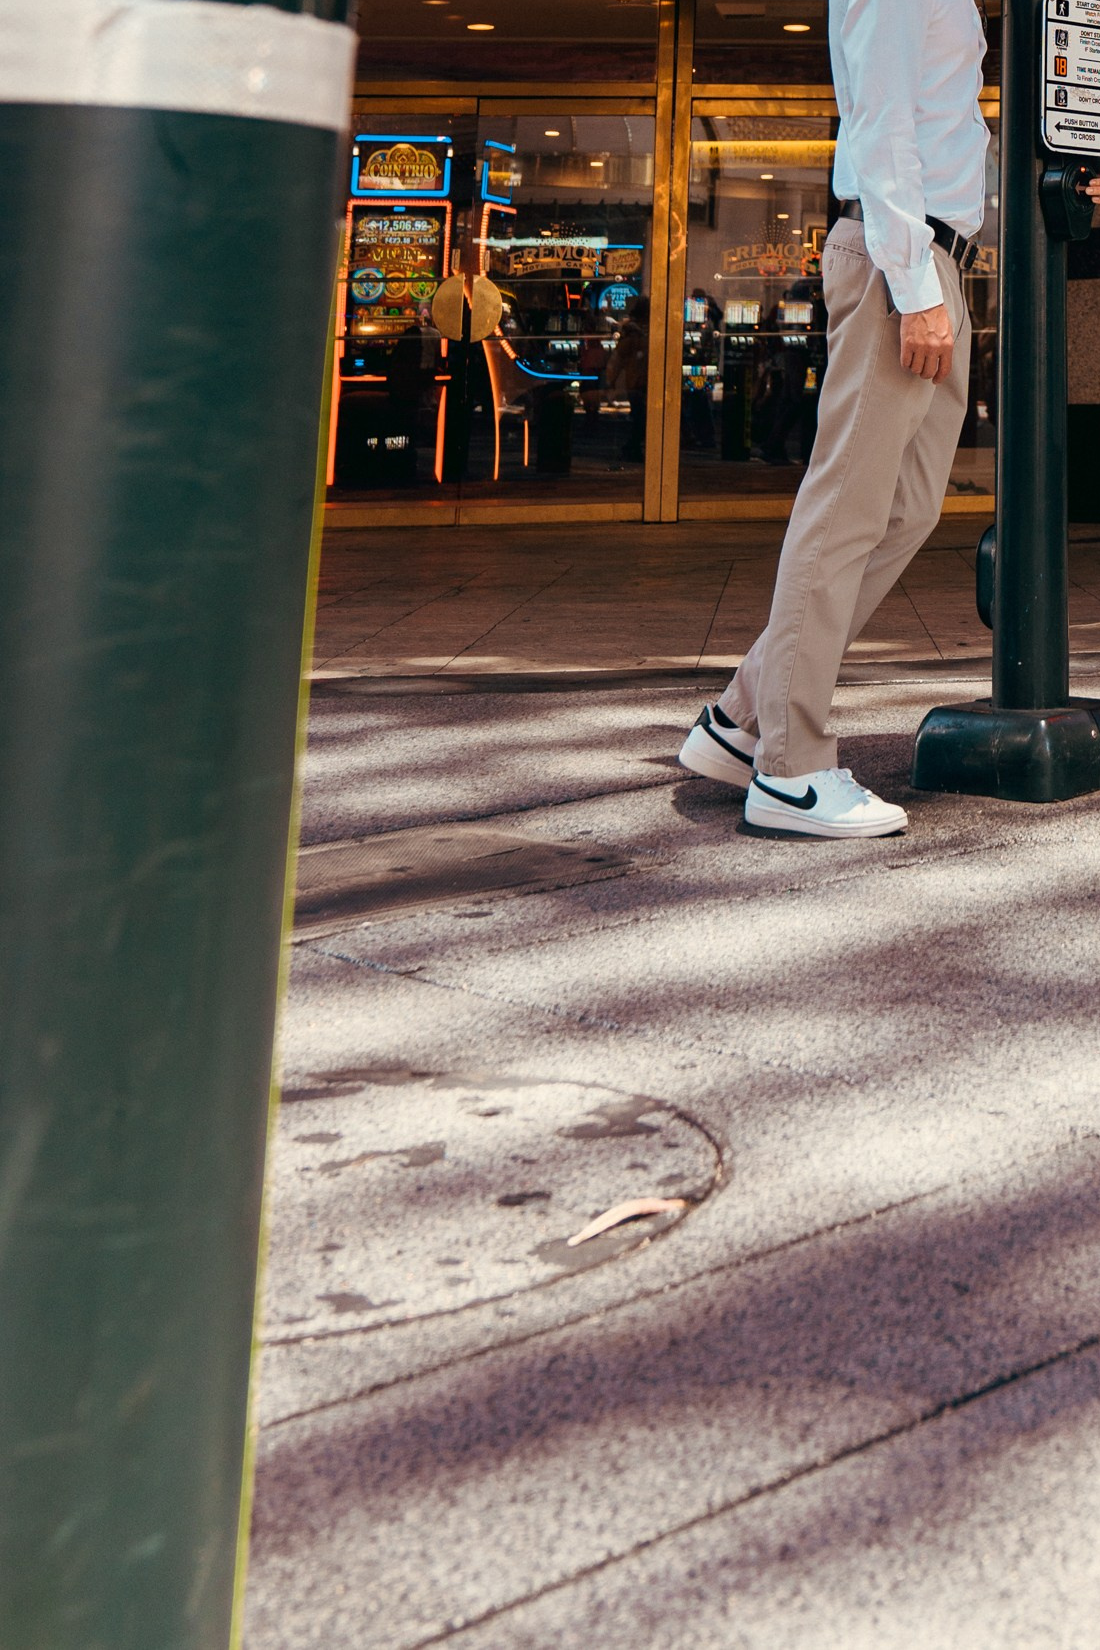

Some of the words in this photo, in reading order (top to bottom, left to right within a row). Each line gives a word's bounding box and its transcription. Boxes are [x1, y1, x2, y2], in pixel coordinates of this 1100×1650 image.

[1076, 0, 1090, 8] START
[1055, 57, 1067, 76] 18
[1064, 118, 1078, 126] PUSH
[1079, 119, 1099, 128] BUTTON
[1070, 132, 1078, 140] TO
[1078, 133, 1096, 141] CROSS
[369, 162, 400, 179] COIN
[402, 162, 436, 179] TRIO
